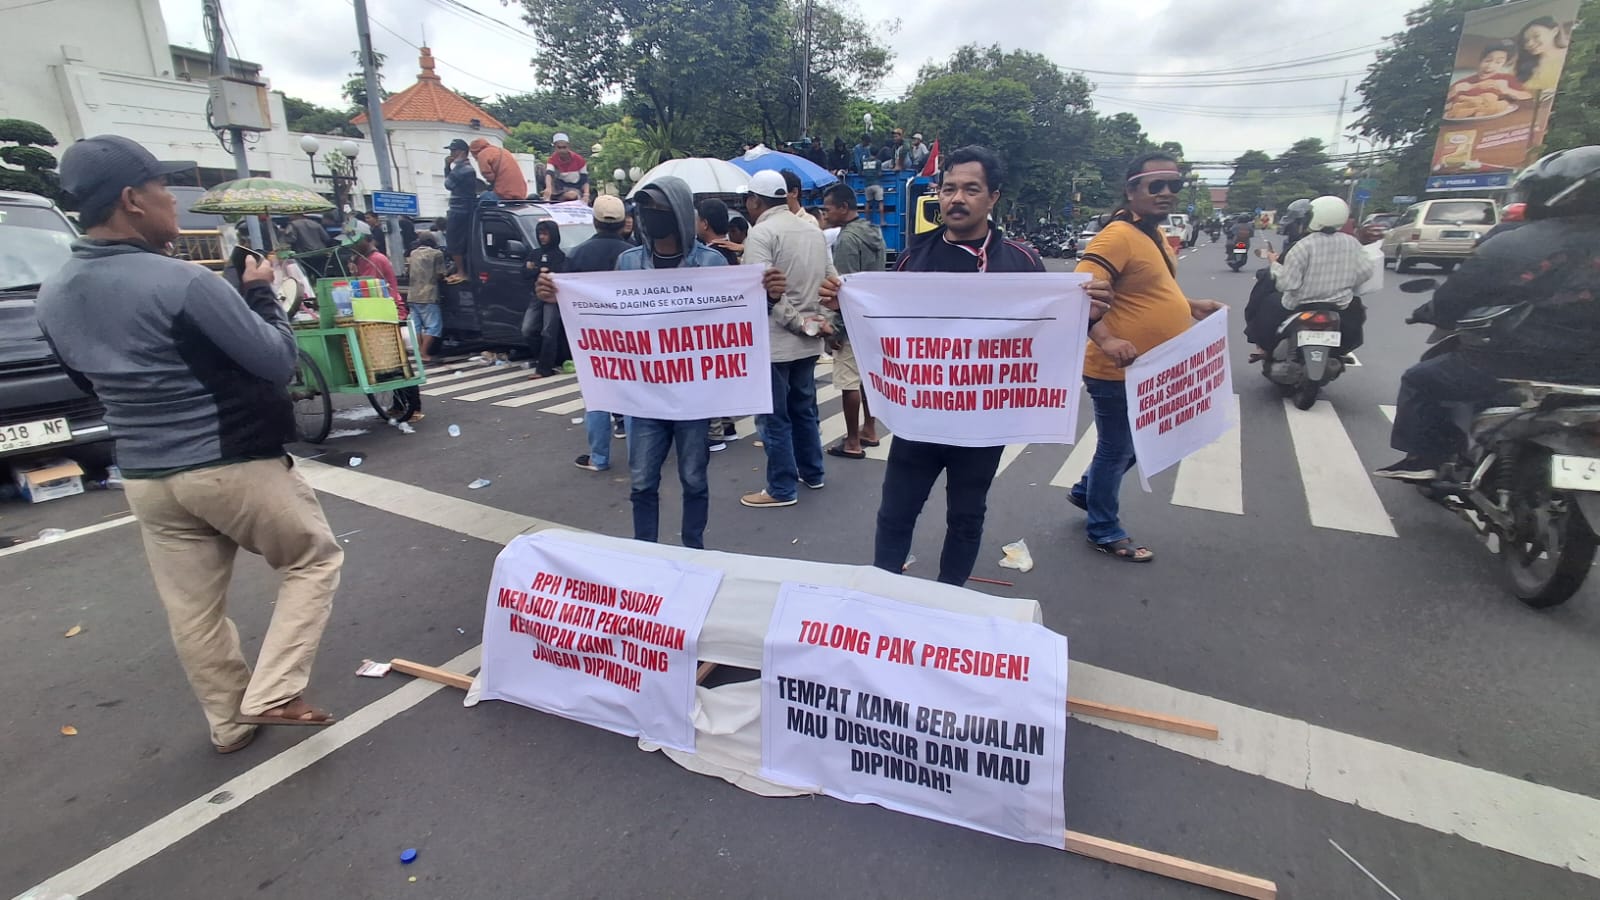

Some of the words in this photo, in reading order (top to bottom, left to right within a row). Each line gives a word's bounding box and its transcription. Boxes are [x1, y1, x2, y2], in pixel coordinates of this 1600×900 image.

[572, 301, 618, 309] PEDAGANG
[620, 300, 656, 309] DAGING
[658, 299, 669, 307] SE
[671, 297, 696, 306] KOTA
[697, 294, 745, 305] SURABAYA
[616, 288, 640, 297] PARA
[642, 287, 671, 296] JAGAL
[673, 285, 693, 293] DAN
[577, 328, 652, 355] JANGAN
[658, 322, 754, 354] MATIKAN
[880, 337, 900, 358] INI
[906, 337, 972, 360] TEMPAT
[978, 337, 1033, 359] NENEK
[590, 355, 637, 381] RIZKI
[640, 358, 694, 384] KAMI
[700, 353, 747, 380] PAK!
[882, 357, 943, 386] MOYANG
[949, 364, 994, 386] KAMI
[998, 363, 1038, 384] PAK!
[1137, 377, 1154, 397] KITA
[1156, 360, 1188, 387] SEPAKAT
[1190, 350, 1205, 370] MAU
[869, 372, 907, 406] TOLONG
[912, 390, 977, 411] JANGAN
[982, 388, 1067, 410] DIPINDAH!
[1139, 389, 1164, 412] KERJA
[1166, 373, 1194, 399] SAMPAI
[43, 419, 63, 435] NF
[1136, 409, 1156, 431] KAMI
[1159, 418, 1172, 435] HAL
[1175, 406, 1195, 427] KAMI
[531, 571, 563, 595] RPH
[563, 578, 617, 608] PEGIRIAN
[619, 589, 664, 616] SUDAH
[497, 588, 558, 620] MENJADI
[558, 603, 595, 629] MATA
[596, 611, 686, 651] PENCAHARIAN
[532, 643, 581, 671] JANGAN
[583, 656, 642, 693] DIPINDAH!
[577, 633, 617, 657] KAMI.
[621, 640, 668, 673] TOLONG
[798, 620, 871, 655] TOLONG
[875, 635, 916, 665] PAK
[920, 644, 1030, 682] PRESIDEN!
[777, 676, 851, 715] TEMPAT
[855, 692, 909, 729] KAMI
[915, 706, 1045, 756] BERJUALAN
[787, 706, 828, 739] MAU
[835, 719, 918, 760] DIGUSUR
[925, 740, 968, 773] DAN
[976, 751, 1031, 786] MAU
[851, 749, 952, 794] DIPINDAH!
